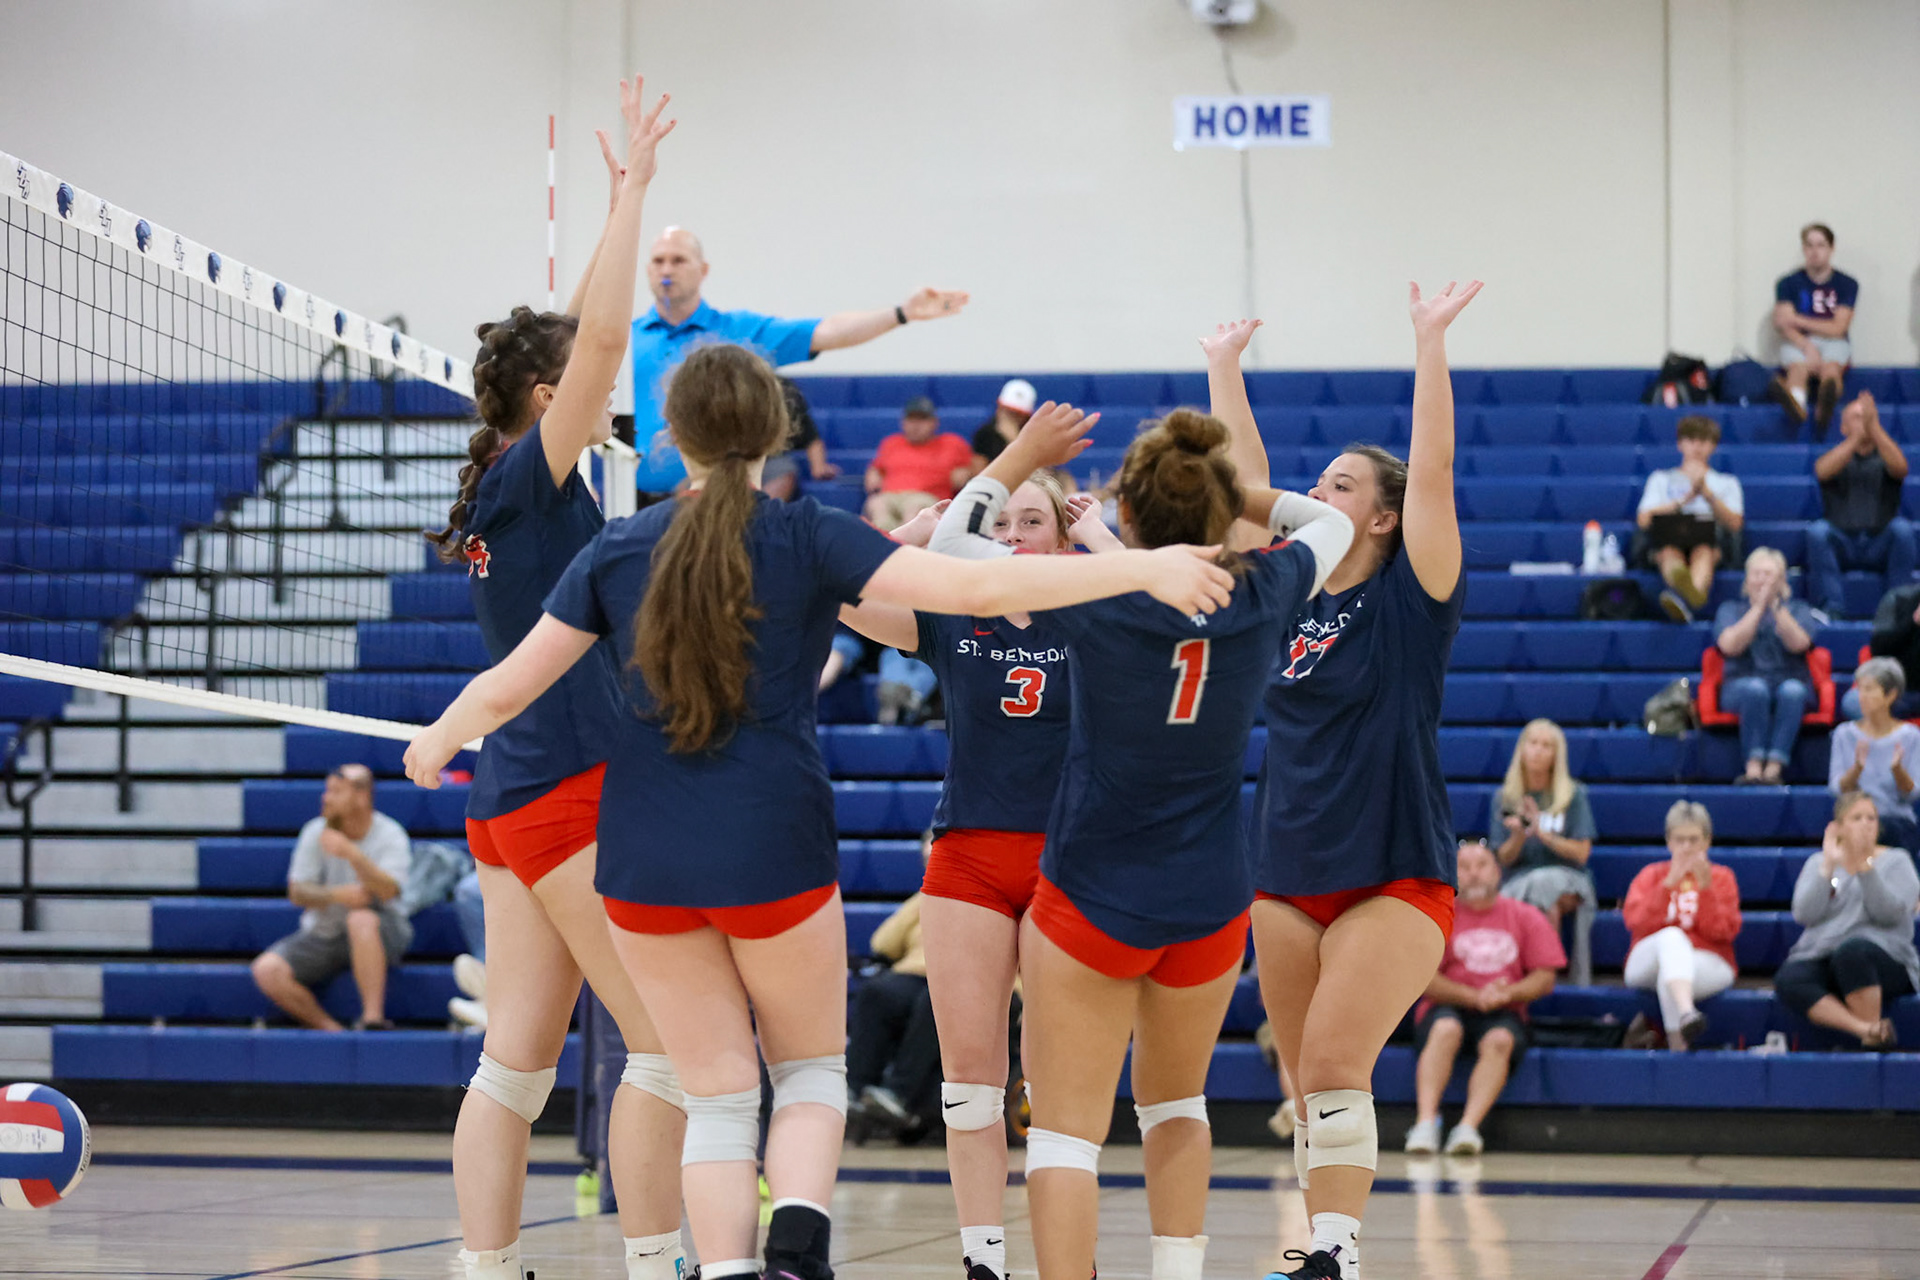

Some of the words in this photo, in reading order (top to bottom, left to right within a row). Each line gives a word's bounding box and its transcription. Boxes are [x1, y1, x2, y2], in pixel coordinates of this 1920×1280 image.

[1194, 104, 1310, 137] HOME
[957, 639, 982, 657] ST.
[1000, 665, 1047, 718] 3
[1166, 638, 1211, 725] 1
